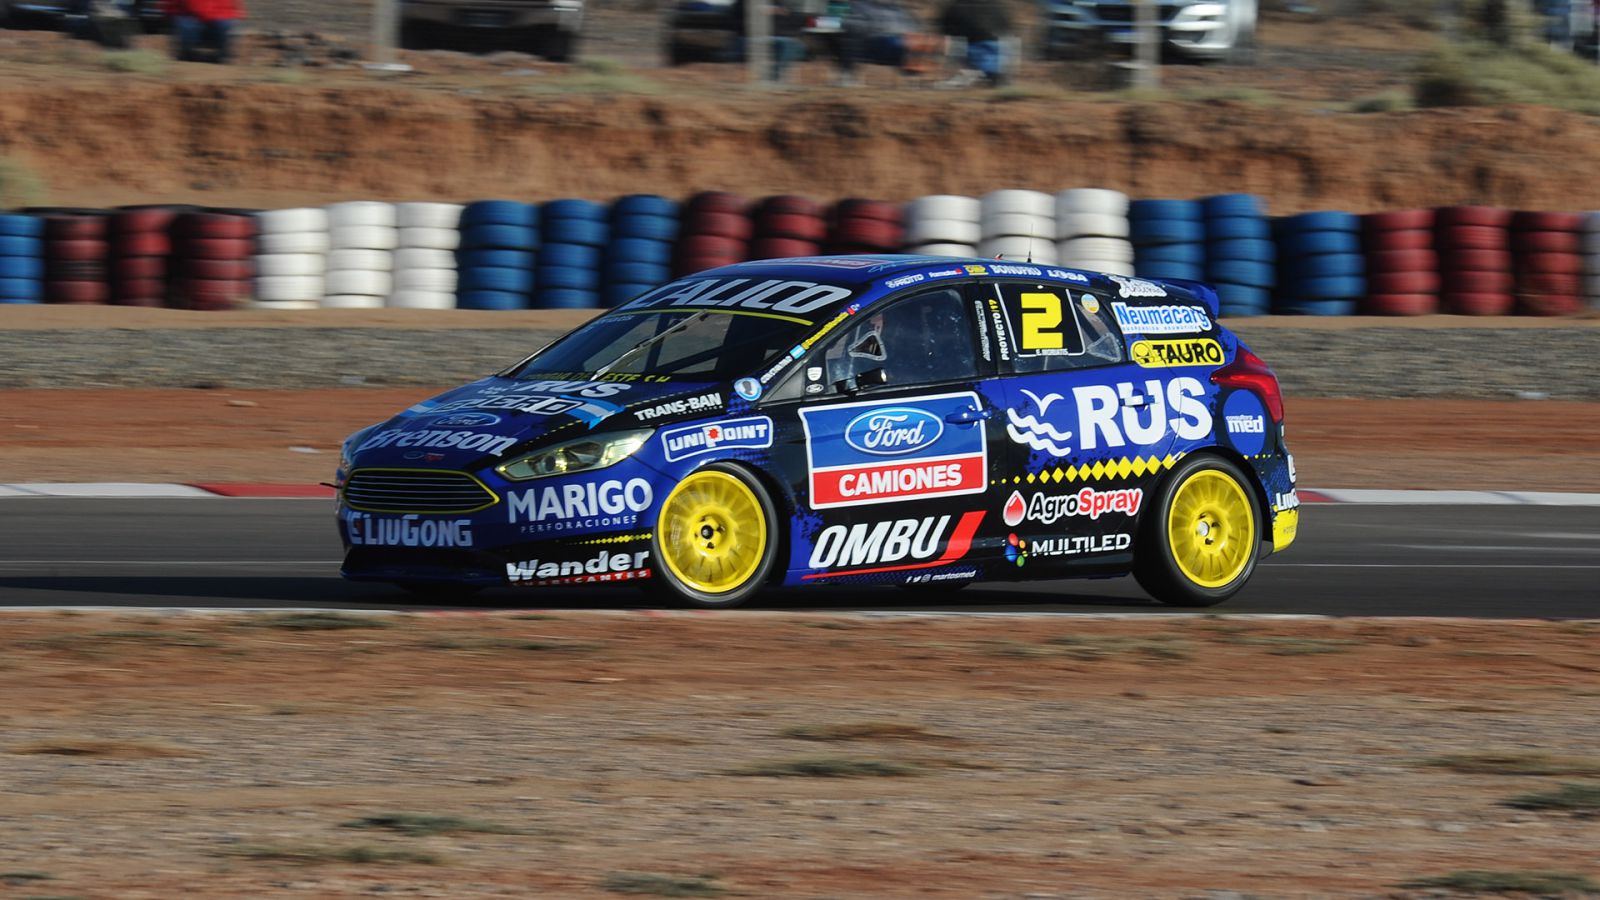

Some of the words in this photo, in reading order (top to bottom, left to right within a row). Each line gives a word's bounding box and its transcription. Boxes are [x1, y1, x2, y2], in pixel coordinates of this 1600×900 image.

[615, 279, 852, 313] CALICO
[1020, 293, 1063, 349] 2
[1152, 342, 1222, 363] TAURO
[514, 380, 631, 398] RUS
[633, 392, 722, 421] TRANS-BAN
[1072, 377, 1213, 450] RUS
[864, 414, 925, 449] Ford
[1228, 415, 1264, 433] med
[357, 429, 518, 456] Brenson
[839, 464, 962, 497] CAMIONES
[507, 478, 653, 523] MARIGO
[1028, 488, 1142, 524] AgroSpray
[521, 515, 638, 533] PERFORACIONES
[808, 515, 951, 569] OMBU
[1032, 534, 1131, 557] MULTILED
[506, 550, 649, 581] Wander
